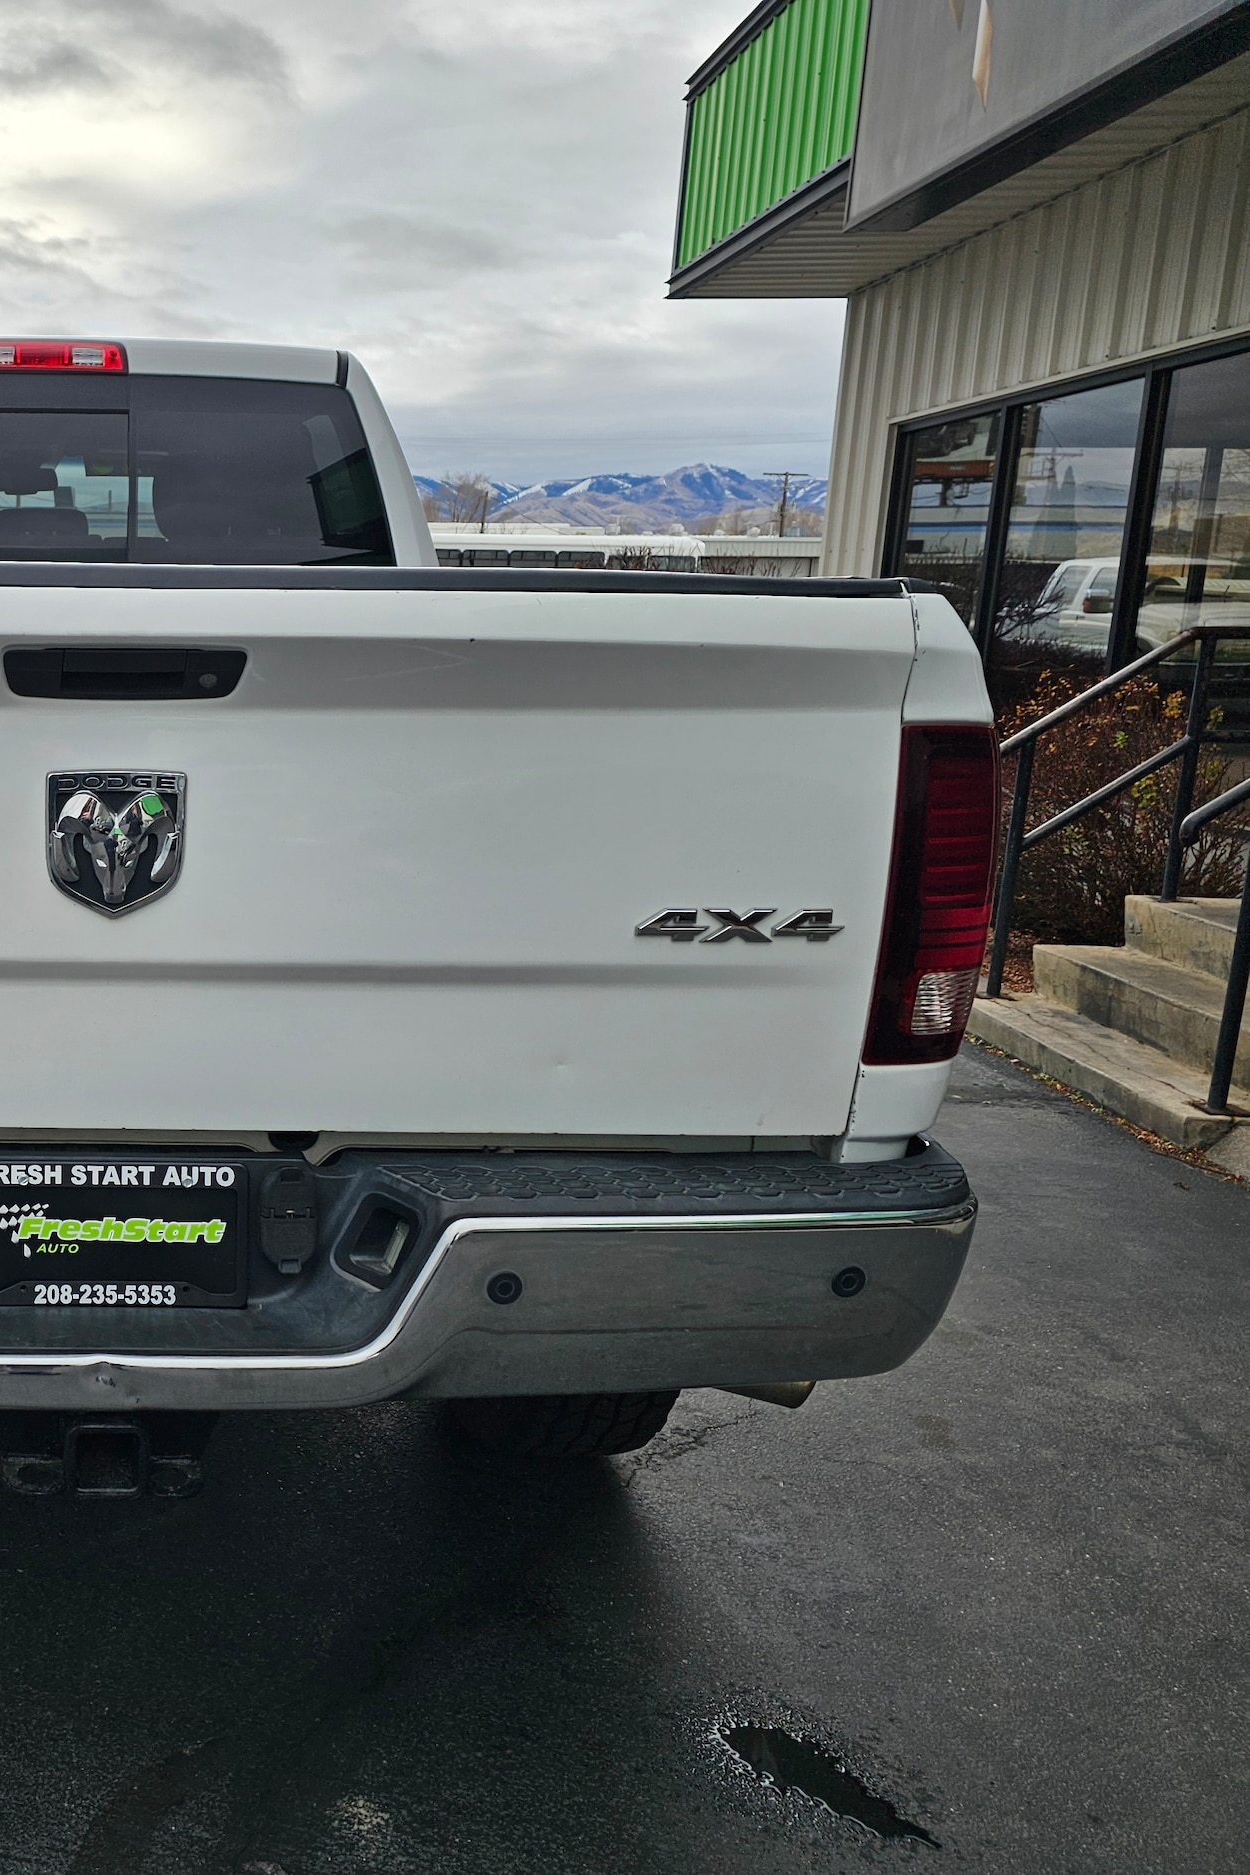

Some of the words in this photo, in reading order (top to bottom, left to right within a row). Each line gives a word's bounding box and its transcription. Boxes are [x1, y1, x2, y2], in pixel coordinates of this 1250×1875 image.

[57, 775, 177, 790] DODGE
[635, 907, 845, 943] 4X4
[71, 1165, 155, 1186] START
[162, 1166, 235, 1188] AUTO
[36, 1243, 80, 1254] AUTO
[33, 1284, 176, 1306] 208-235-5353
